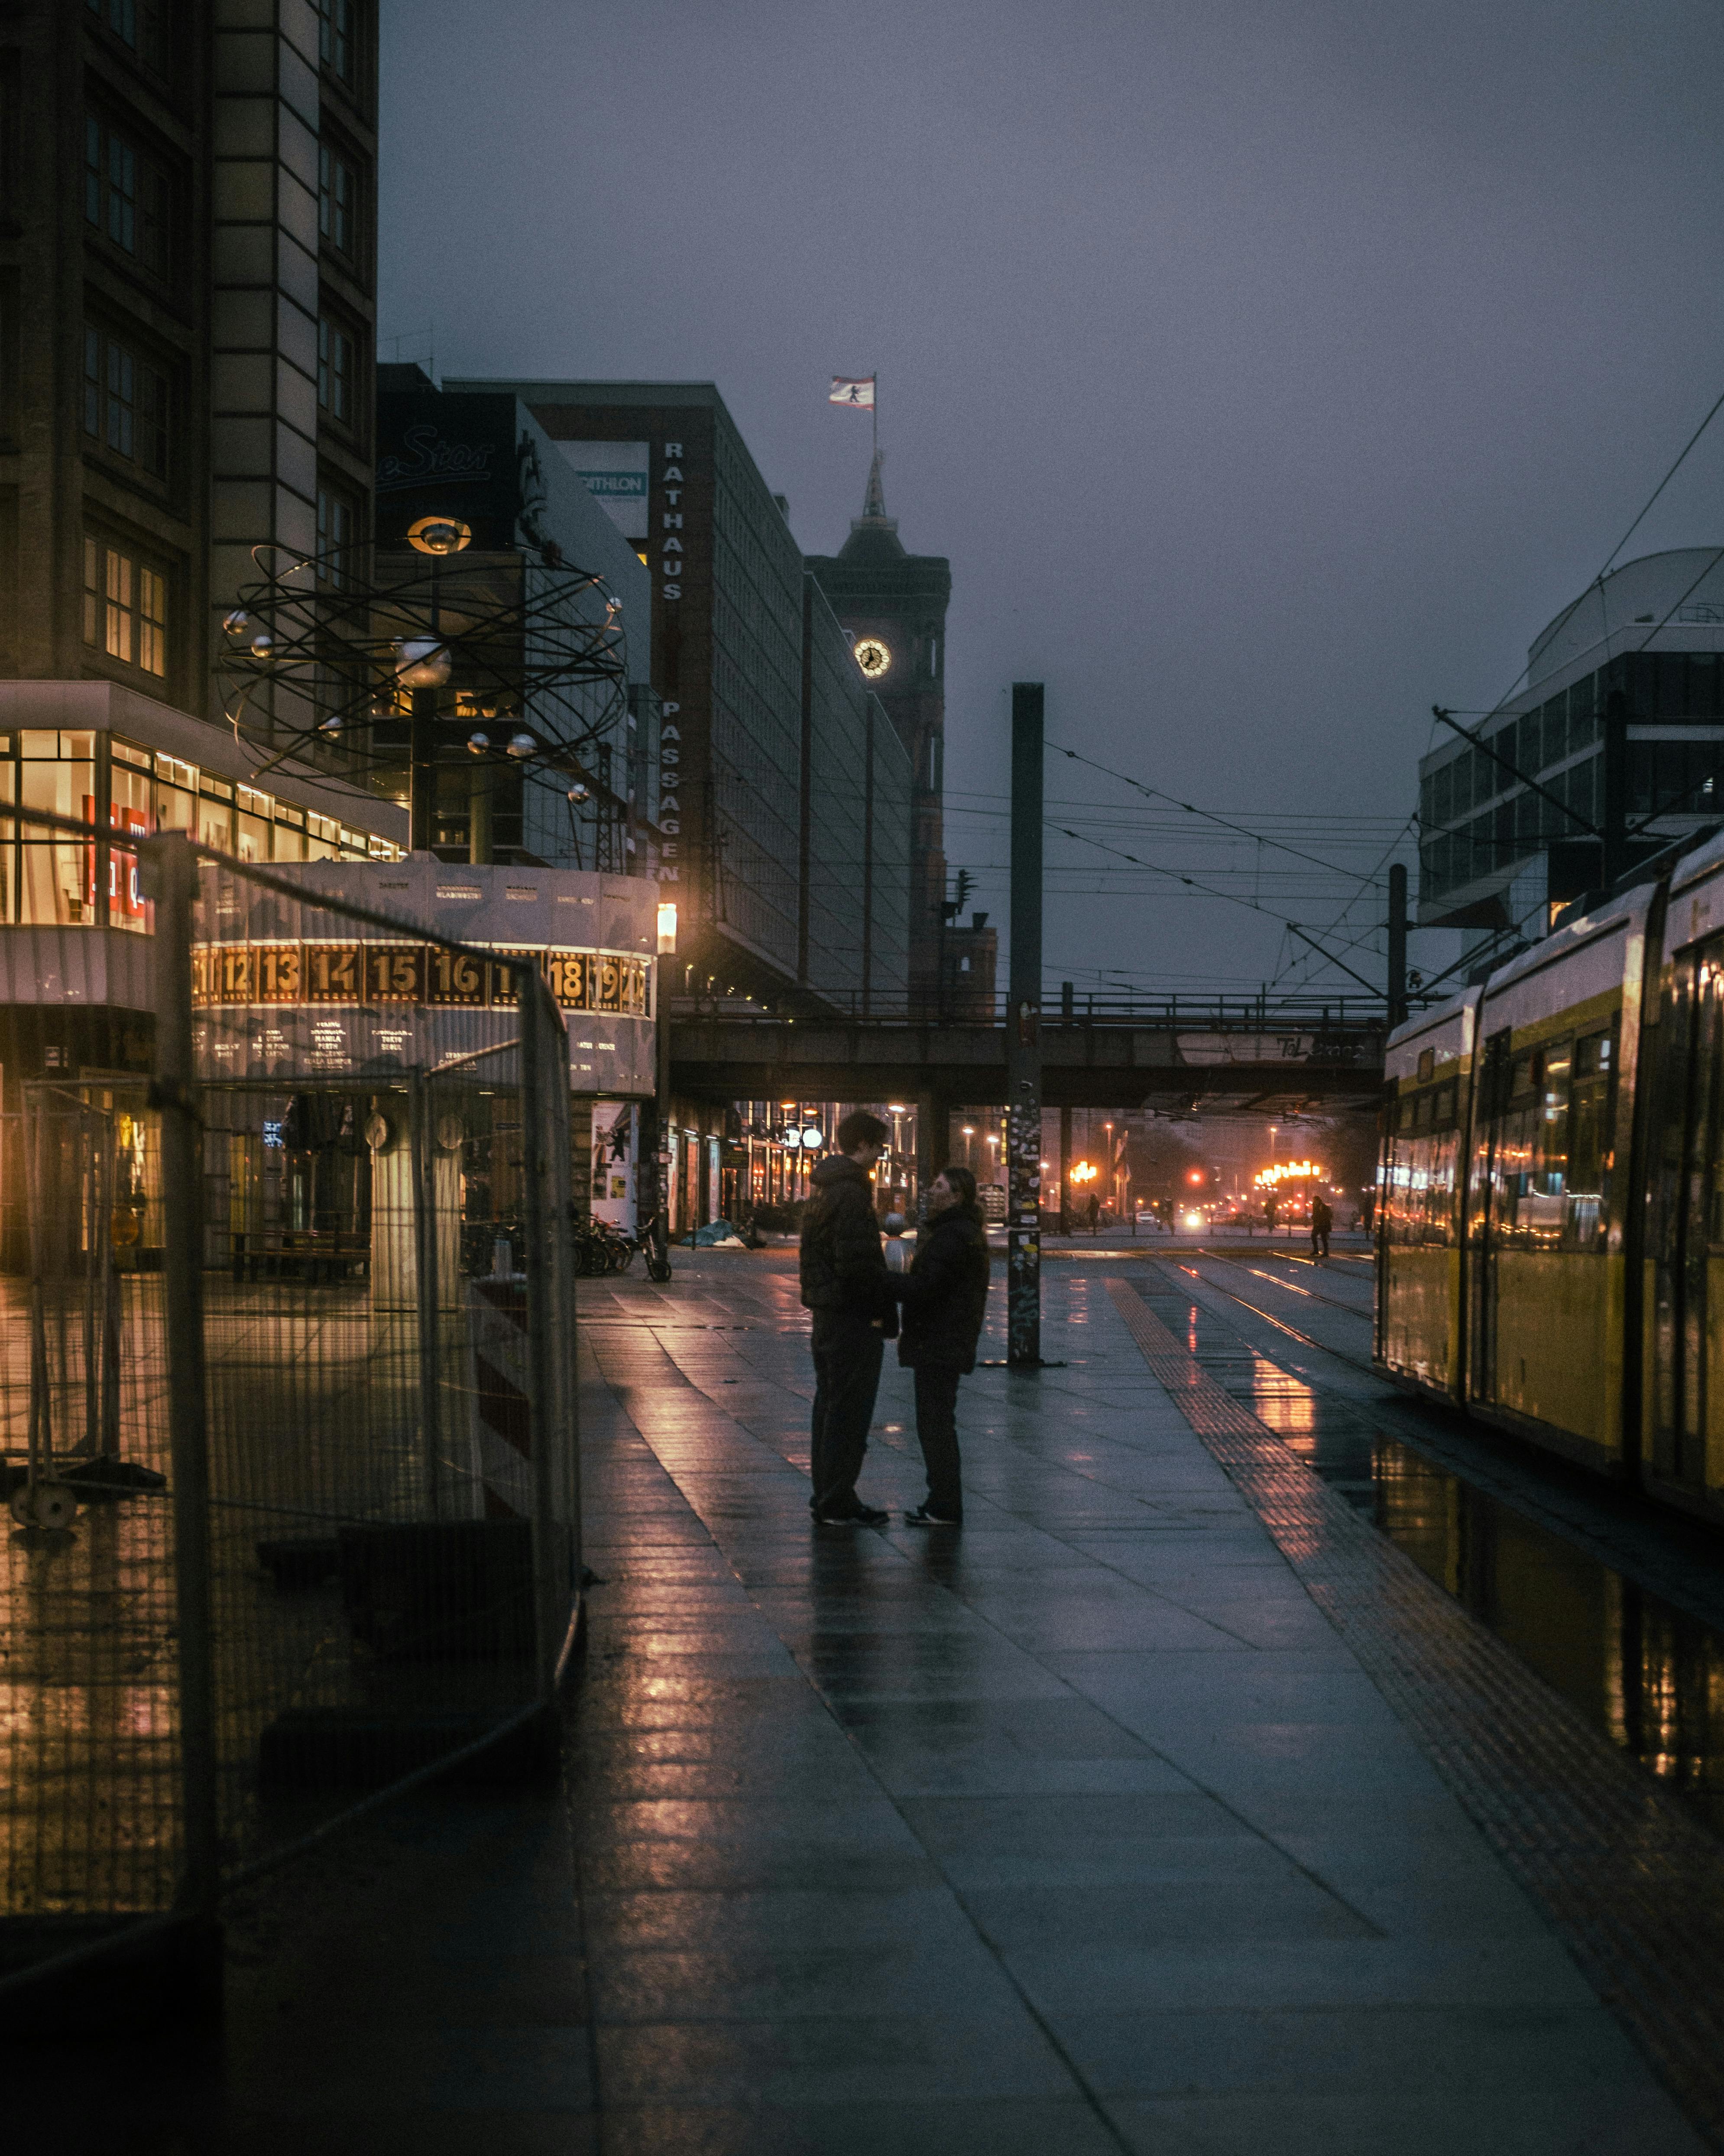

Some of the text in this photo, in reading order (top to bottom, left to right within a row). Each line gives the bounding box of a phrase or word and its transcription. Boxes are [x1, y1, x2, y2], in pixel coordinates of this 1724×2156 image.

[663, 443, 683, 600] RATHAUS
[661, 702, 681, 881] PASSAGEN
[224, 955, 251, 990] 12
[263, 953, 299, 990] 13
[315, 954, 354, 990] 14
[373, 955, 416, 991] 15
[434, 955, 479, 992] 16
[550, 961, 582, 997] 18
[592, 964, 619, 1000] 19
